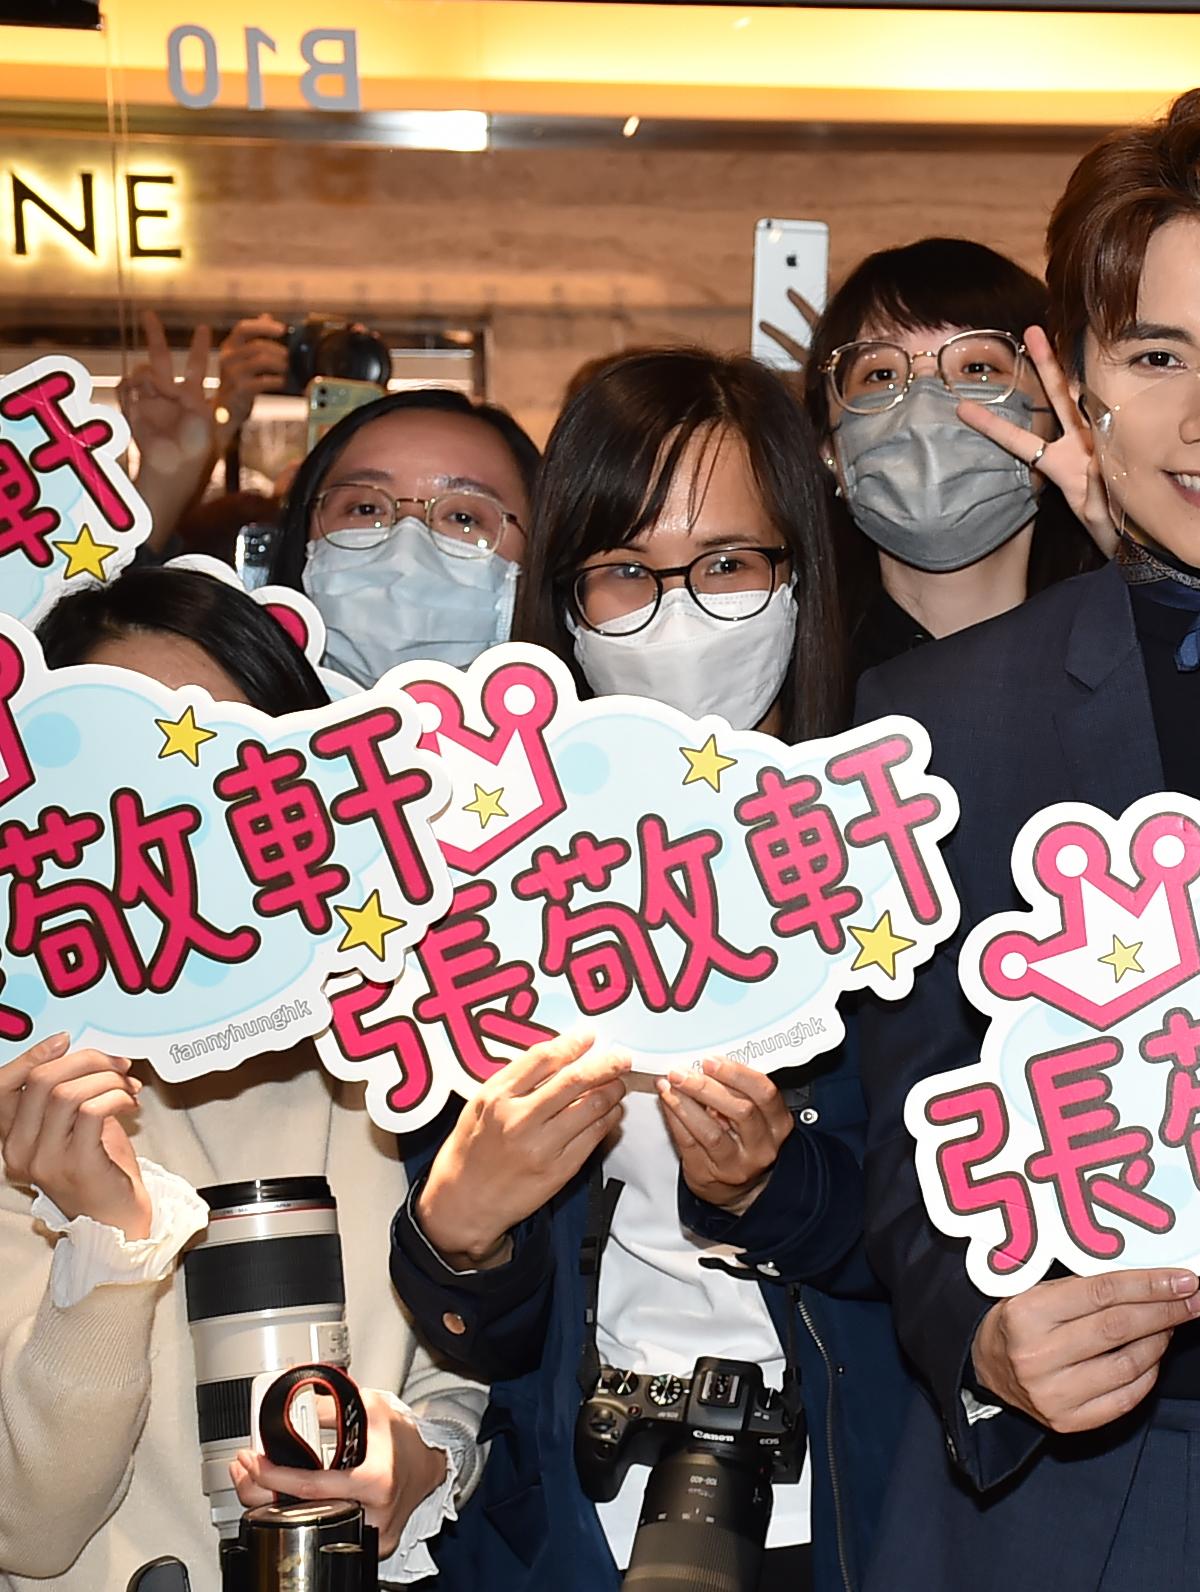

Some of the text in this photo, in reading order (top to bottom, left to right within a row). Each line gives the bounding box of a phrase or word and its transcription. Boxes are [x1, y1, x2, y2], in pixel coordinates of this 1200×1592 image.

[11, 172, 182, 258] NE
[0, 706, 432, 1041] 敬軒
[331, 734, 941, 1113] 張敬軒
[169, 1000, 312, 1064] fannyhunghk
[692, 1017, 827, 1072] fnyhunghk
[693, 1429, 735, 1443] Canon
[759, 1437, 780, 1446] EOS
